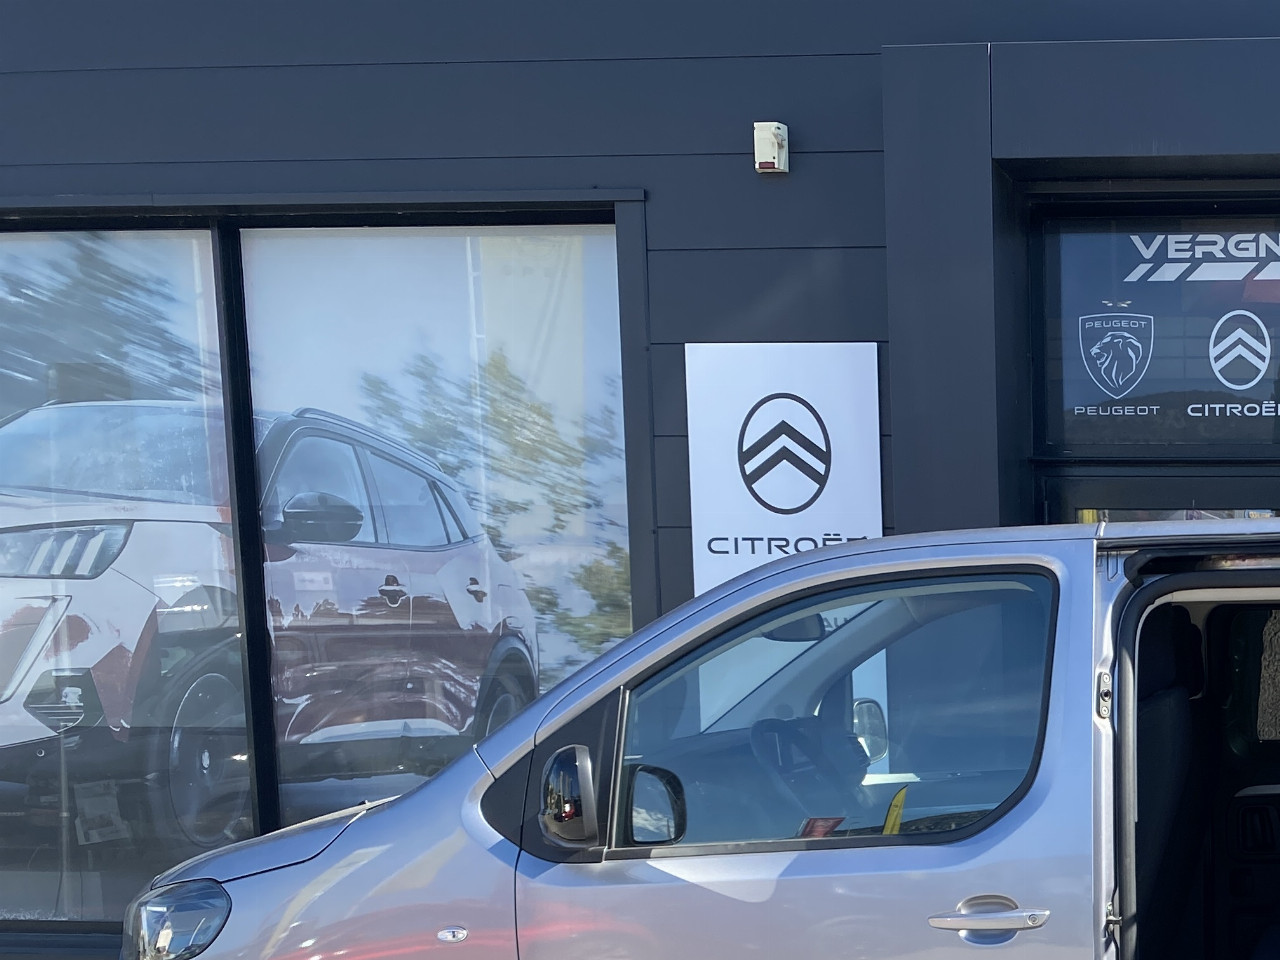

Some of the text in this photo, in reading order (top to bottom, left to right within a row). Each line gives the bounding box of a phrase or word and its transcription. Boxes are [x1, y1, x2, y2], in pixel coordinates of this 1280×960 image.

[1085, 319, 1148, 330] PEUGEOT
[1074, 405, 1161, 416] PEUGEOT
[707, 533, 868, 555] CITROË
